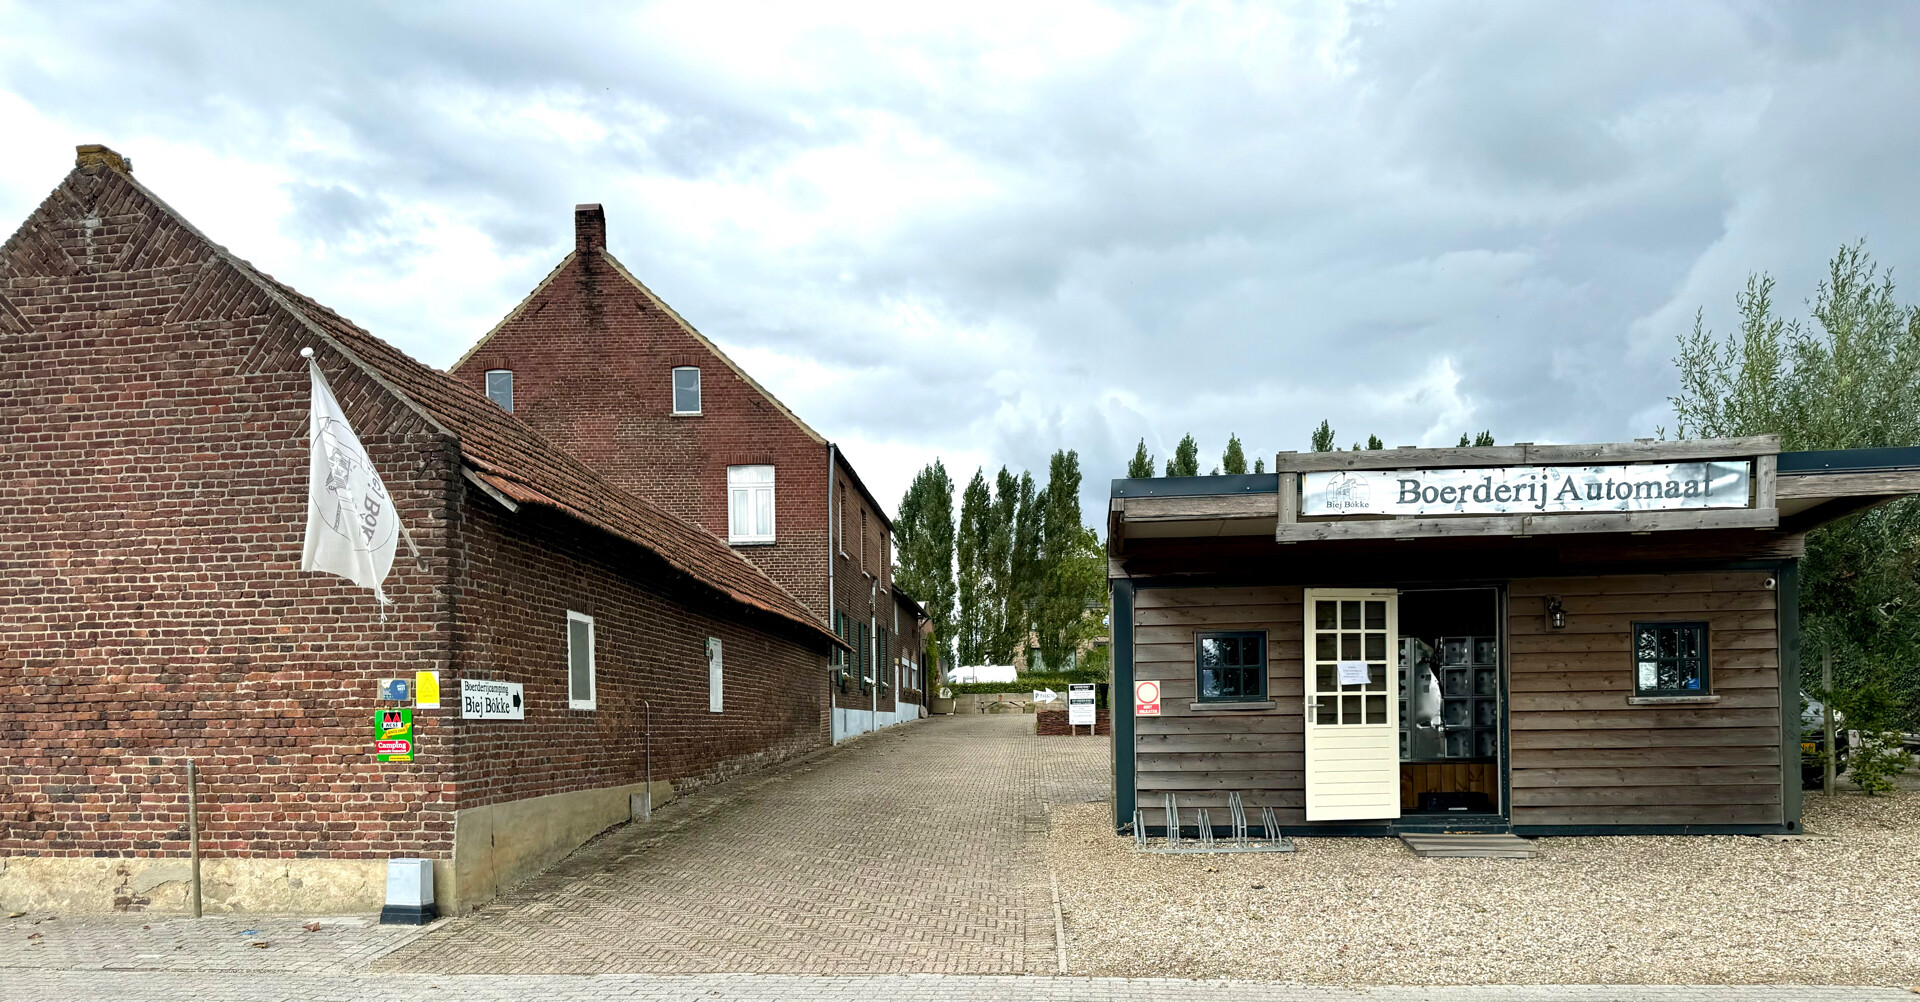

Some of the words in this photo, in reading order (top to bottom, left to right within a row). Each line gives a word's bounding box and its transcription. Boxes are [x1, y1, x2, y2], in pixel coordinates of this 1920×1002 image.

[1396, 474, 1548, 509] Boerderij
[1556, 475, 1713, 501] Automaat
[1326, 501, 1342, 509] Biej
[464, 681, 509, 696] Boerderijcamping
[465, 696, 483, 717] Biej
[485, 697, 510, 713] Bôkke
[378, 741, 407, 750] Camping
